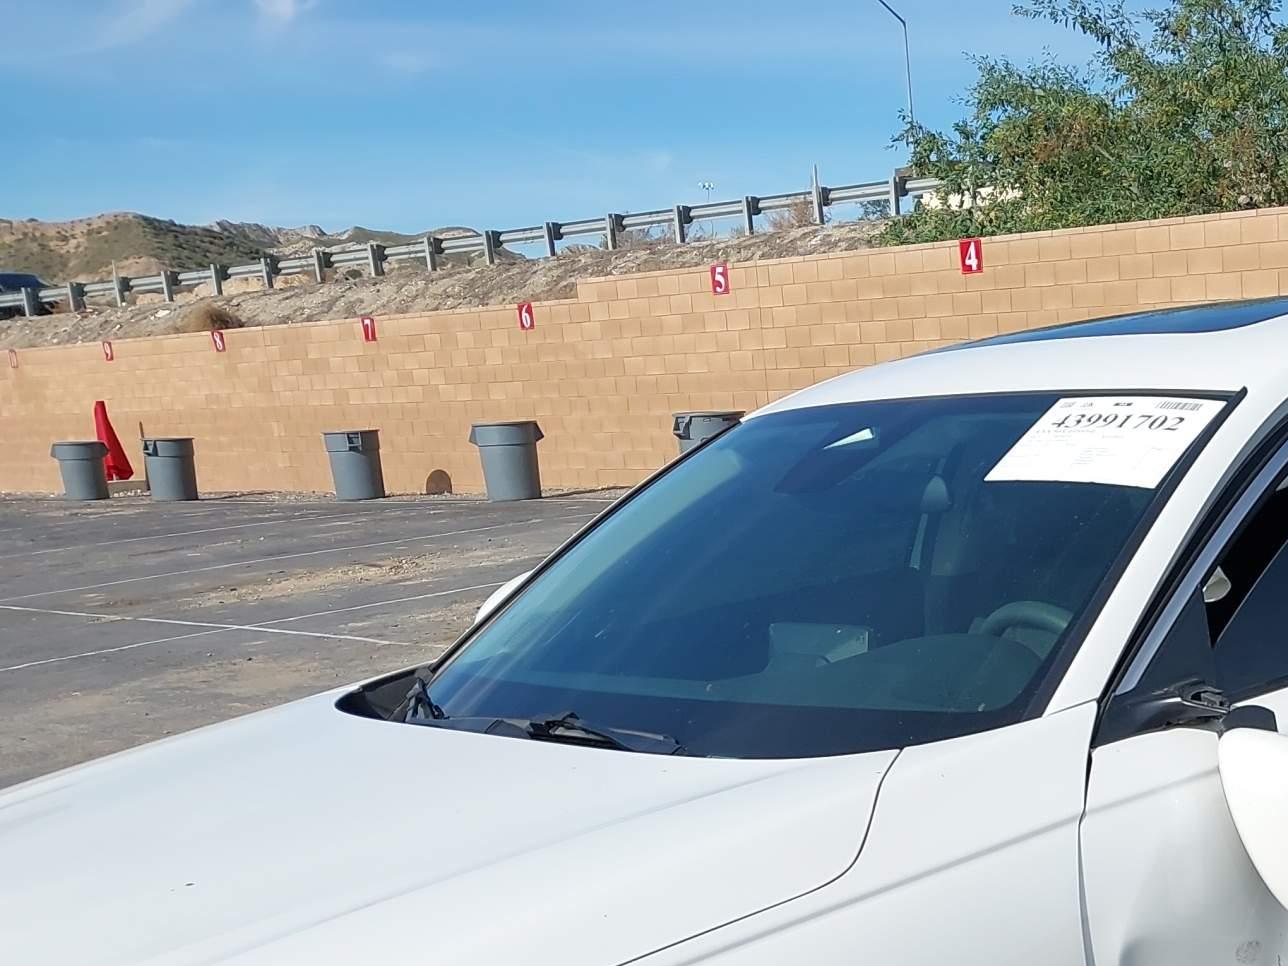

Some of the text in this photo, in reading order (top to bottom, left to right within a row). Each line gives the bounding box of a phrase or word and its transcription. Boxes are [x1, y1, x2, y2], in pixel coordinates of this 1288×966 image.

[965, 241, 978, 271] 4
[714, 266, 725, 292] 5
[521, 304, 531, 329] 6
[363, 319, 372, 340] 7
[103, 342, 111, 360] 9
[213, 331, 223, 350] 8
[1051, 413, 1185, 431] 43991702
